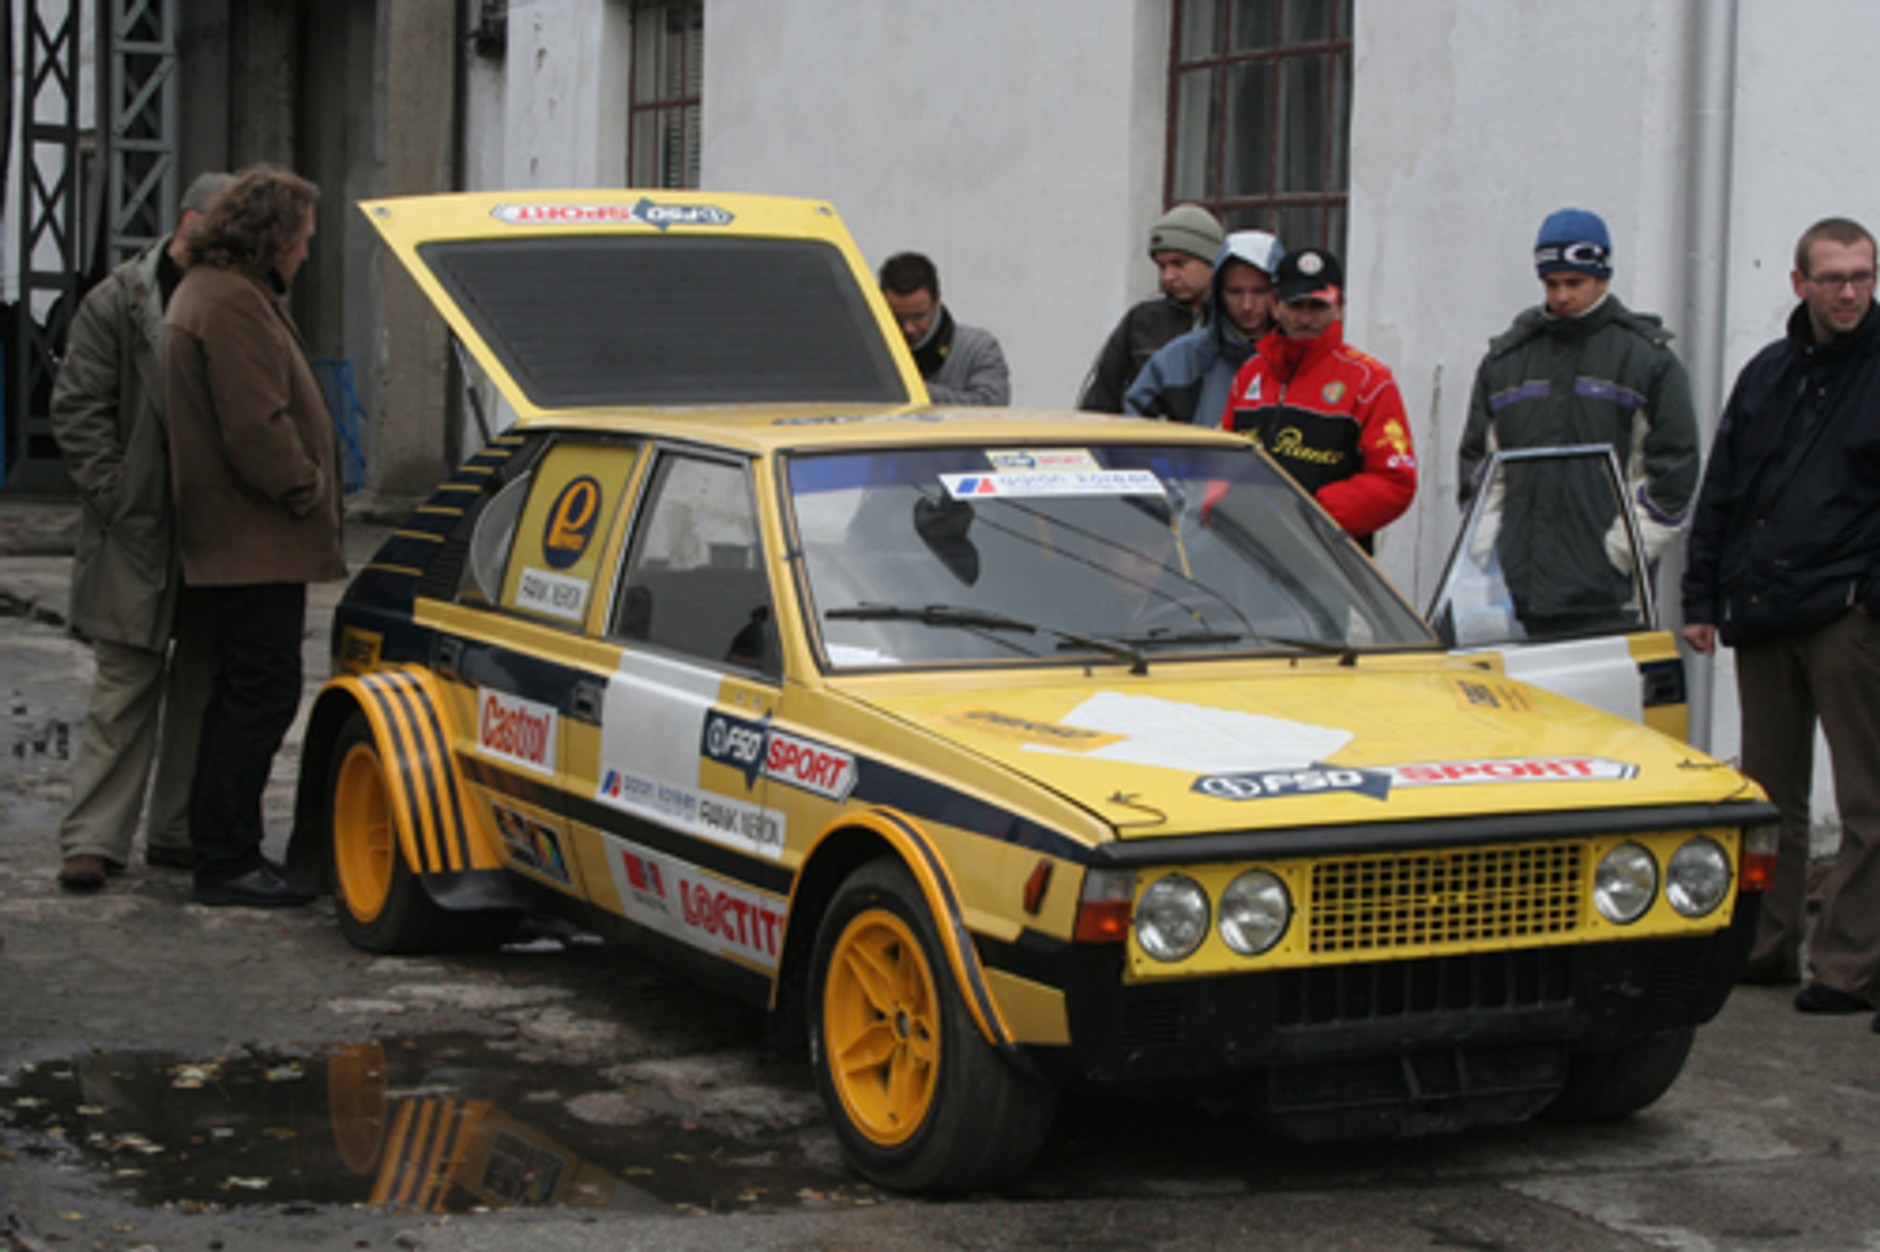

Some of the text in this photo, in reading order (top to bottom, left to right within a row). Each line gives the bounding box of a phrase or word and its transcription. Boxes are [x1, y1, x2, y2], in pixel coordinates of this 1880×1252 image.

[516, 205, 631, 220] SPORT
[480, 695, 551, 765] Castrol
[765, 738, 849, 791] SPORT
[1397, 759, 1598, 783] SPORT
[679, 878, 786, 958] LOCTIT
